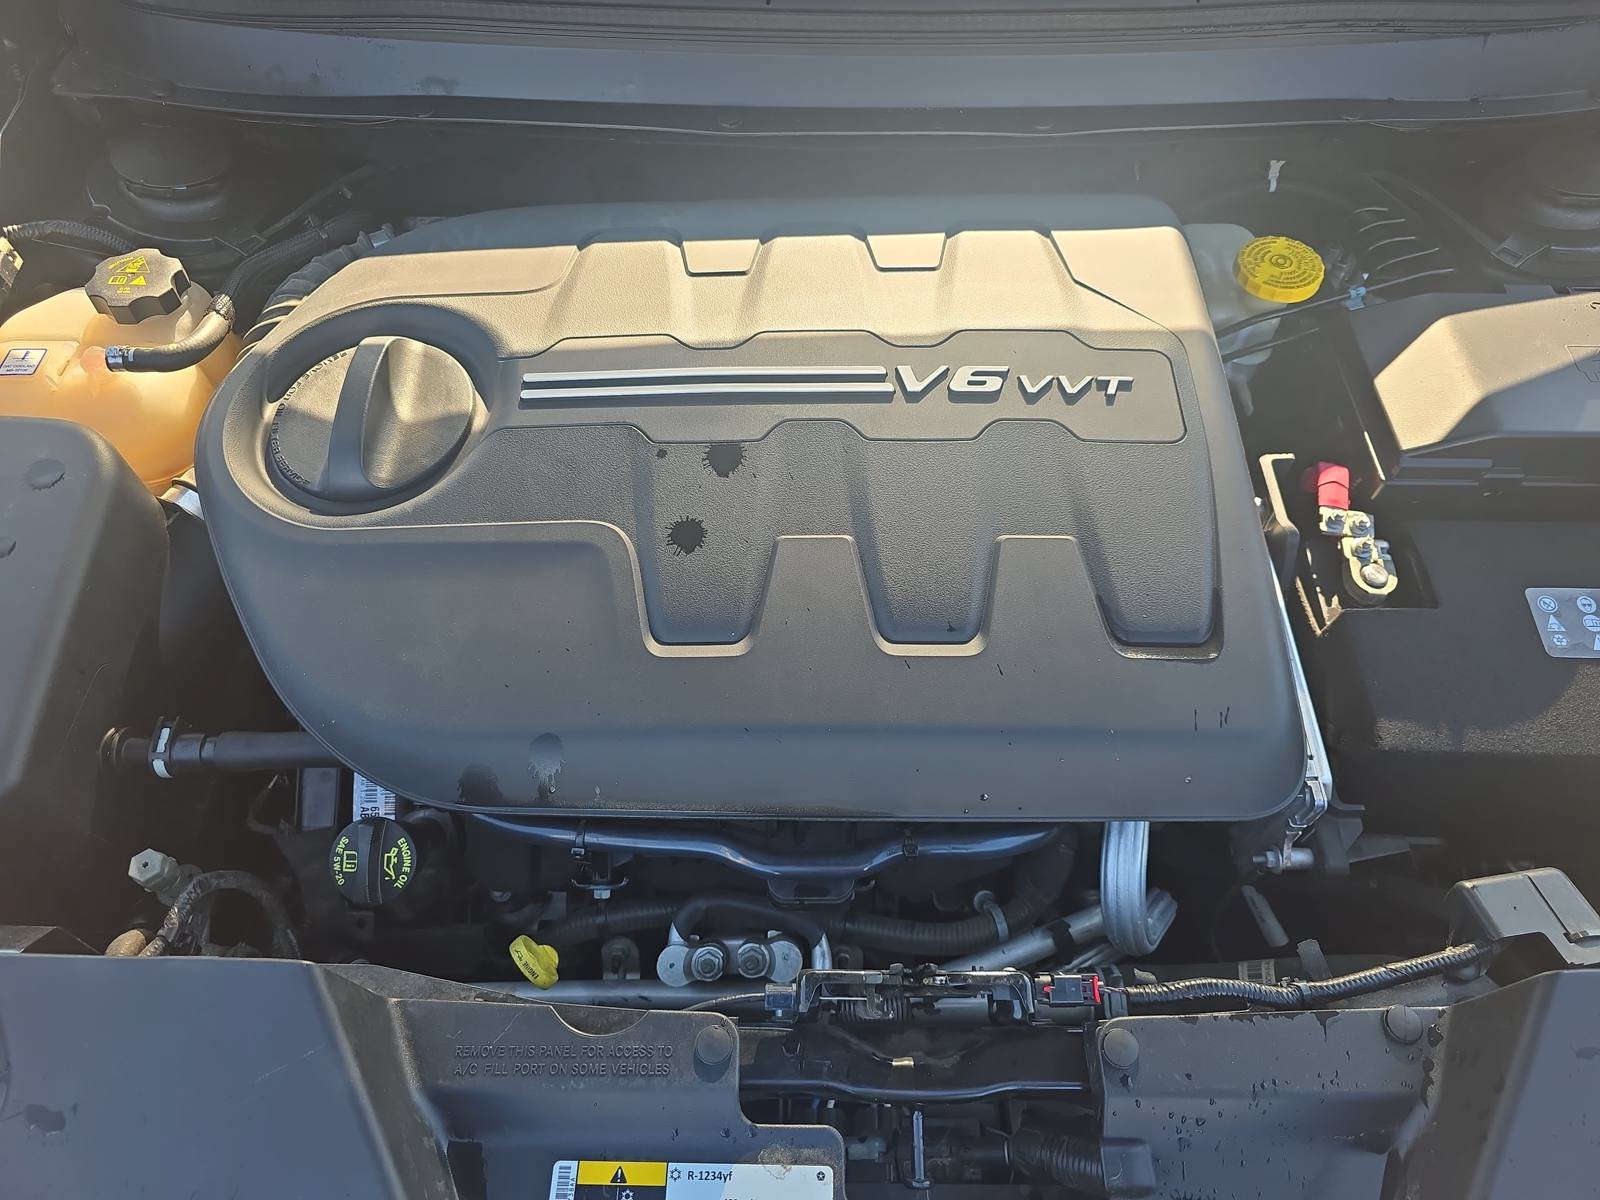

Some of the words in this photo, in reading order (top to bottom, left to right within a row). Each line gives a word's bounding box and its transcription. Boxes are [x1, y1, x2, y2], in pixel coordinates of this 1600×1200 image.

[895, 365, 1010, 404] V6
[1017, 375, 1135, 407] VVT
[335, 836, 349, 855] SAE
[397, 837, 412, 873] ENGINE
[333, 856, 345, 886] 5W-20
[393, 874, 408, 889] OIL
[456, 1045, 506, 1057] REMOVE
[510, 1045, 536, 1057] THIS
[539, 1045, 577, 1057] PANEL
[581, 1045, 604, 1057] FOR
[607, 1045, 655, 1057] ACCESS
[657, 1045, 673, 1057] TO
[454, 1063, 479, 1075] A/C
[484, 1063, 509, 1075] FILL
[513, 1063, 546, 1075] PORT
[549, 1063, 568, 1075] ON
[571, 1063, 607, 1075] SOME
[612, 1063, 671, 1075] VEHICLES
[687, 1170, 733, 1183] R-1234yf
